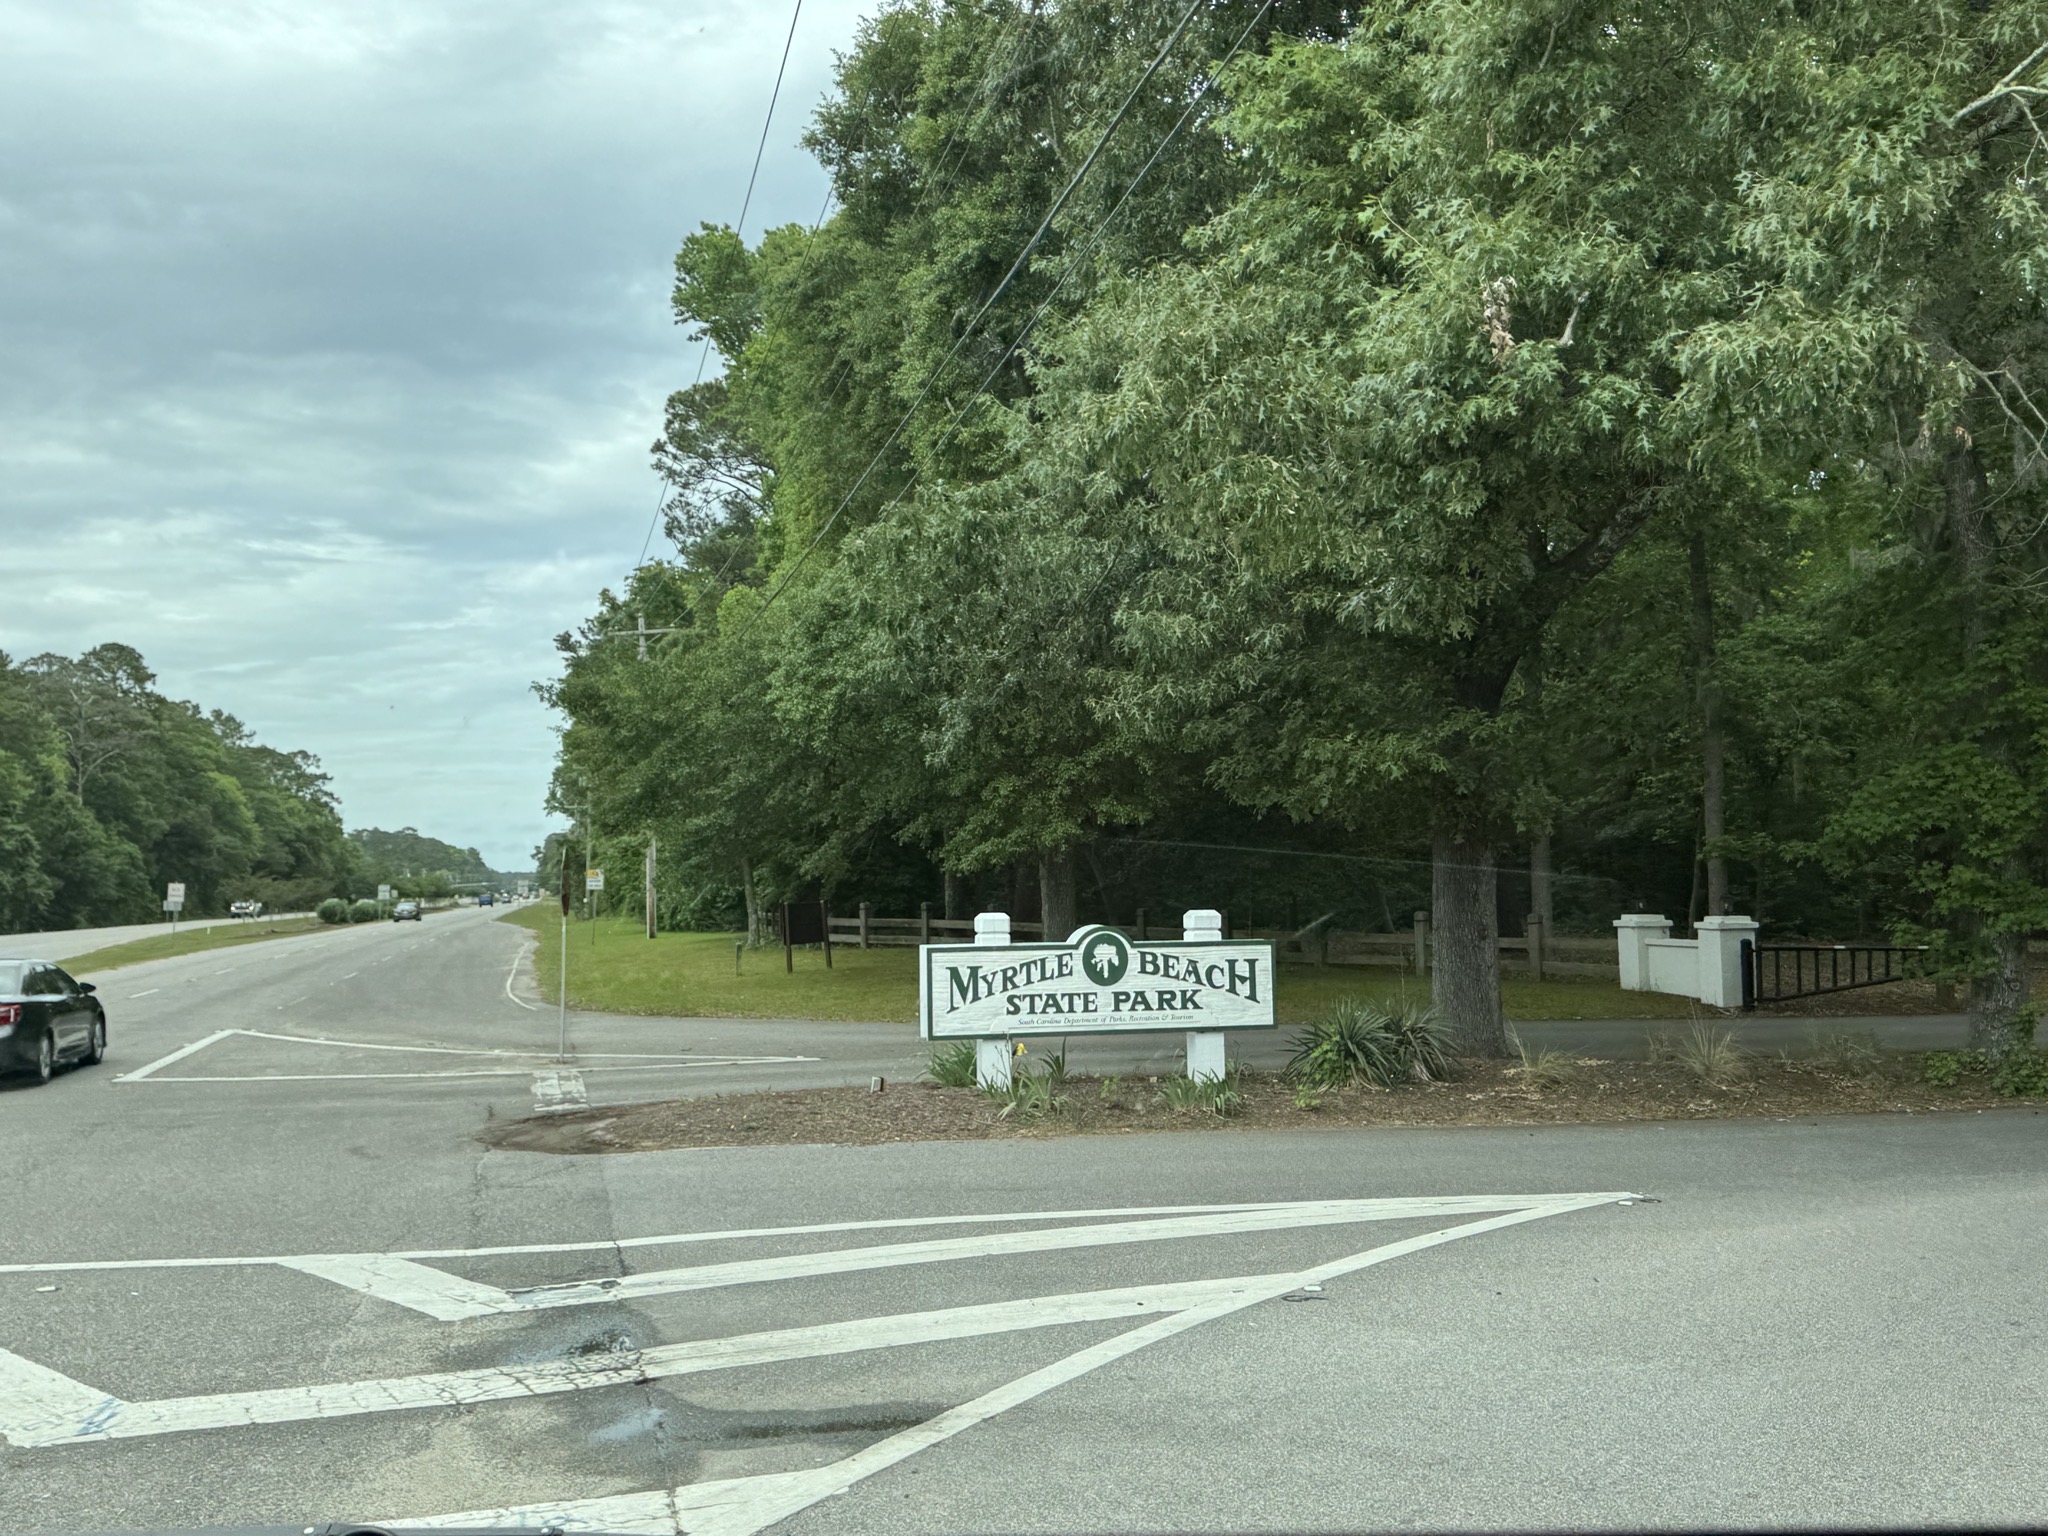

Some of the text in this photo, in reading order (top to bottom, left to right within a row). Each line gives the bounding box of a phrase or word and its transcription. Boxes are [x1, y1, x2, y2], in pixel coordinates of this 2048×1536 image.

[945, 950, 1261, 1014] MYRTLE BEACH
[1006, 989, 1204, 1016] STATE PARK
[1018, 1018, 1035, 1026] South
[1036, 1017, 1062, 1025] Carolina
[1064, 1016, 1099, 1026] Department
[1100, 1016, 1108, 1024] of
[1128, 1014, 1160, 1022] Recreation
[1170, 1013, 1194, 1021] Tourism
